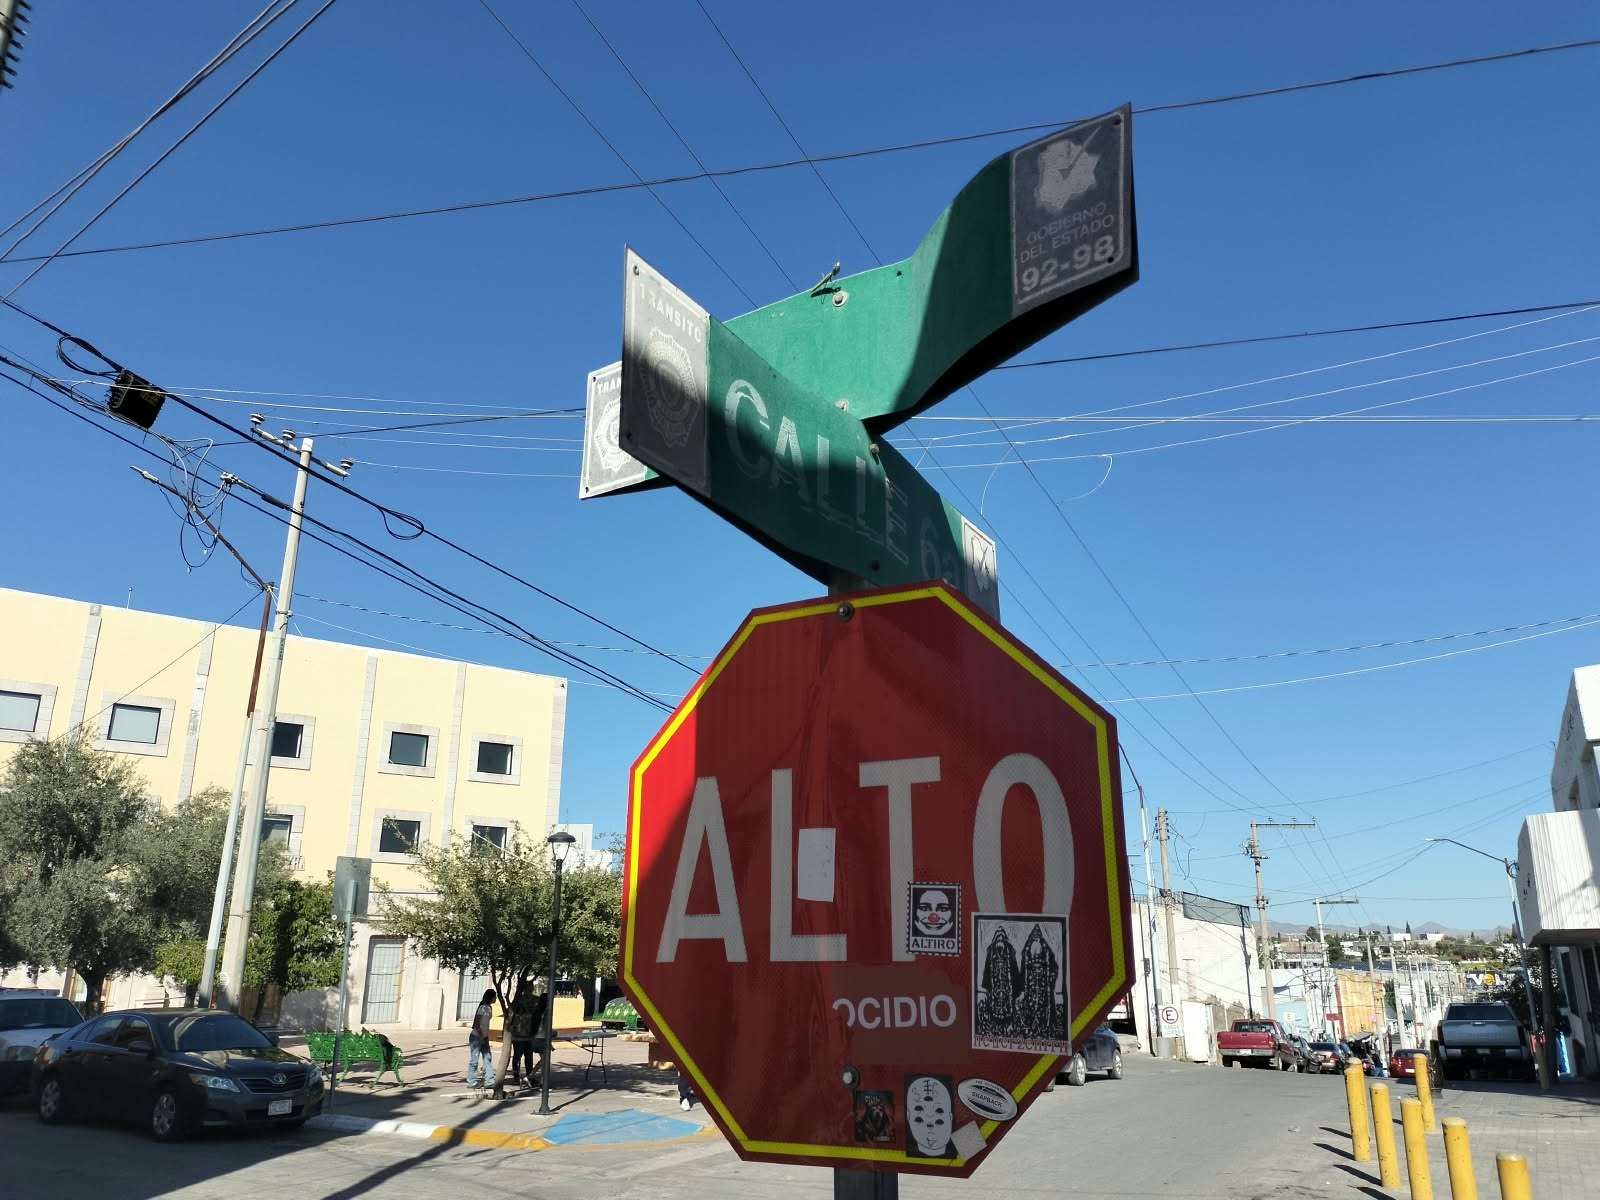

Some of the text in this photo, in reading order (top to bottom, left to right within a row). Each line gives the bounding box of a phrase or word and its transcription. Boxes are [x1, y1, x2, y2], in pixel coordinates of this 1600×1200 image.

[1019, 214, 1115, 264] DEL ESTADO
[1025, 200, 1108, 245] GOBIERNO
[1021, 234, 1115, 292] 92-98
[639, 283, 702, 343] TRANSITO
[724, 378, 910, 566] CALLE
[655, 752, 1075, 963] ALTO
[911, 937, 956, 951] ALTIRO
